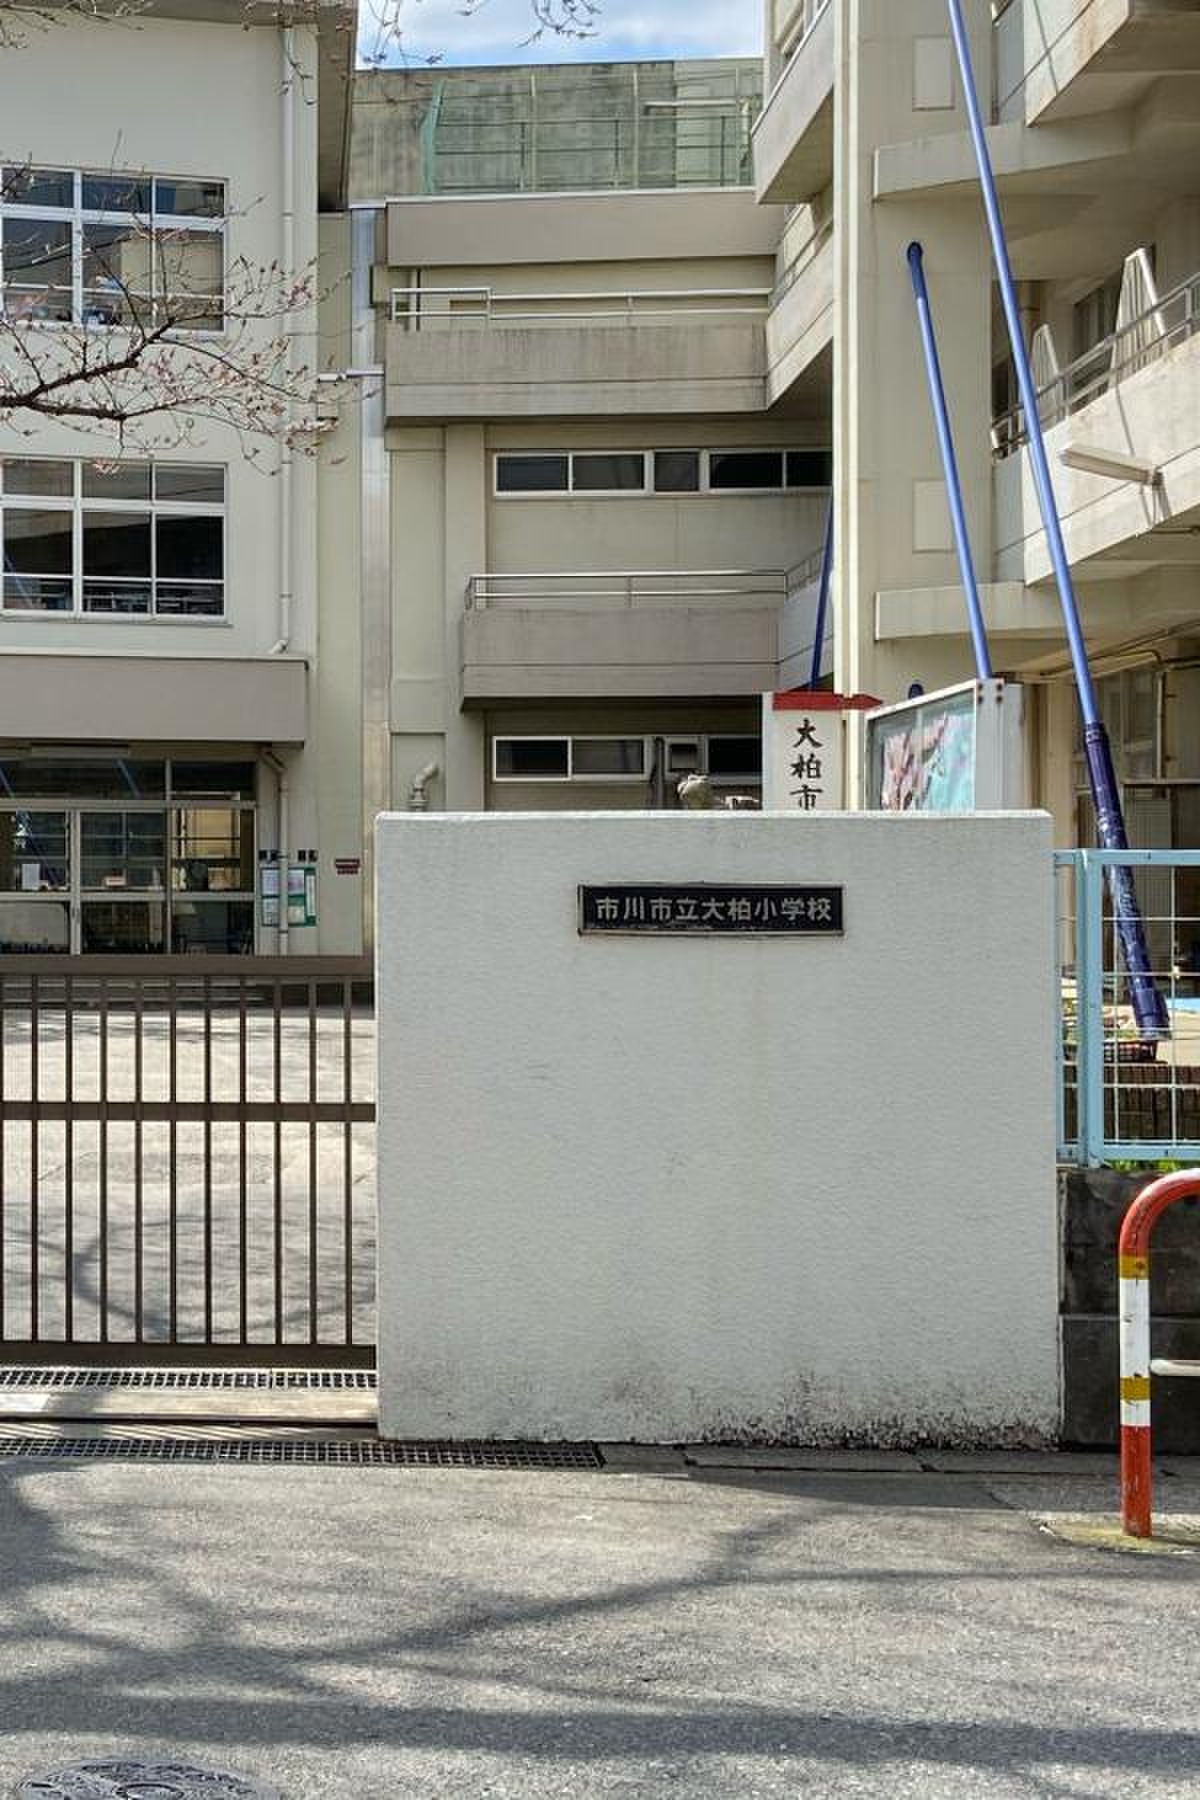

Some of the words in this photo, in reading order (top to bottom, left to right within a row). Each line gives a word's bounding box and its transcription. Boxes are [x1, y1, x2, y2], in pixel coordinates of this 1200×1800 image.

[595, 896, 832, 921] 市川市立大柏小学校
